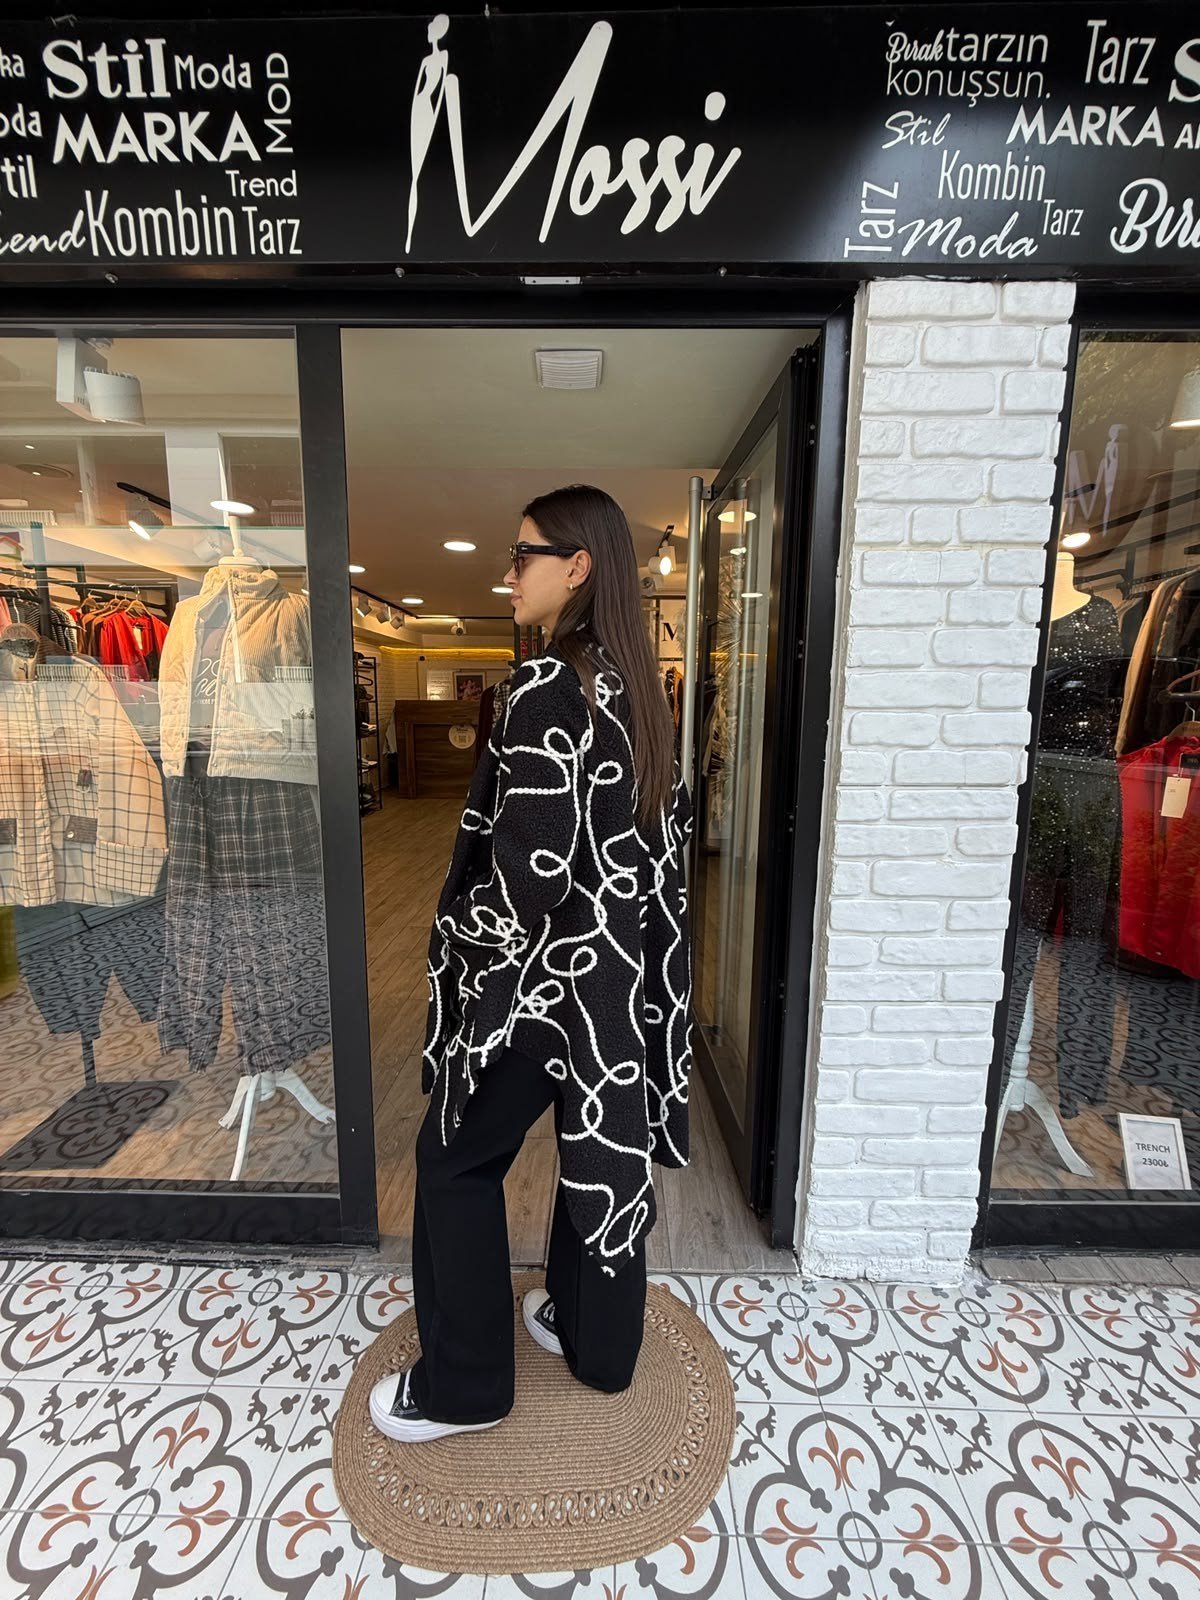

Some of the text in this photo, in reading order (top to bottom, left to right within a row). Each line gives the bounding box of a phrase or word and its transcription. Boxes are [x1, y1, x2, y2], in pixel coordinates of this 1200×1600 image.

[42, 38, 172, 99] Stil
[946, 27, 1049, 63] tarzın
[1086, 19, 1156, 84] Tarz
[174, 54, 252, 90] Moda
[886, 62, 1051, 108] konuşsun.
[263, 52, 294, 153] MOD
[1005, 105, 1165, 147] MARKA
[52, 110, 262, 164] MARKA
[405, 14, 742, 254] Mossi
[881, 110, 951, 149] Stil
[225, 170, 297, 198] Trend
[938, 150, 1046, 202] Kombin
[85, 189, 238, 257] Kombin
[242, 205, 303, 255] Tarz
[843, 180, 900, 259] Tarz
[897, 211, 1039, 260] Moda
[1042, 199, 1085, 236] Tarz
[1109, 178, 1200, 254] Bır
[1135, 1142, 1171, 1153] TRENCH
